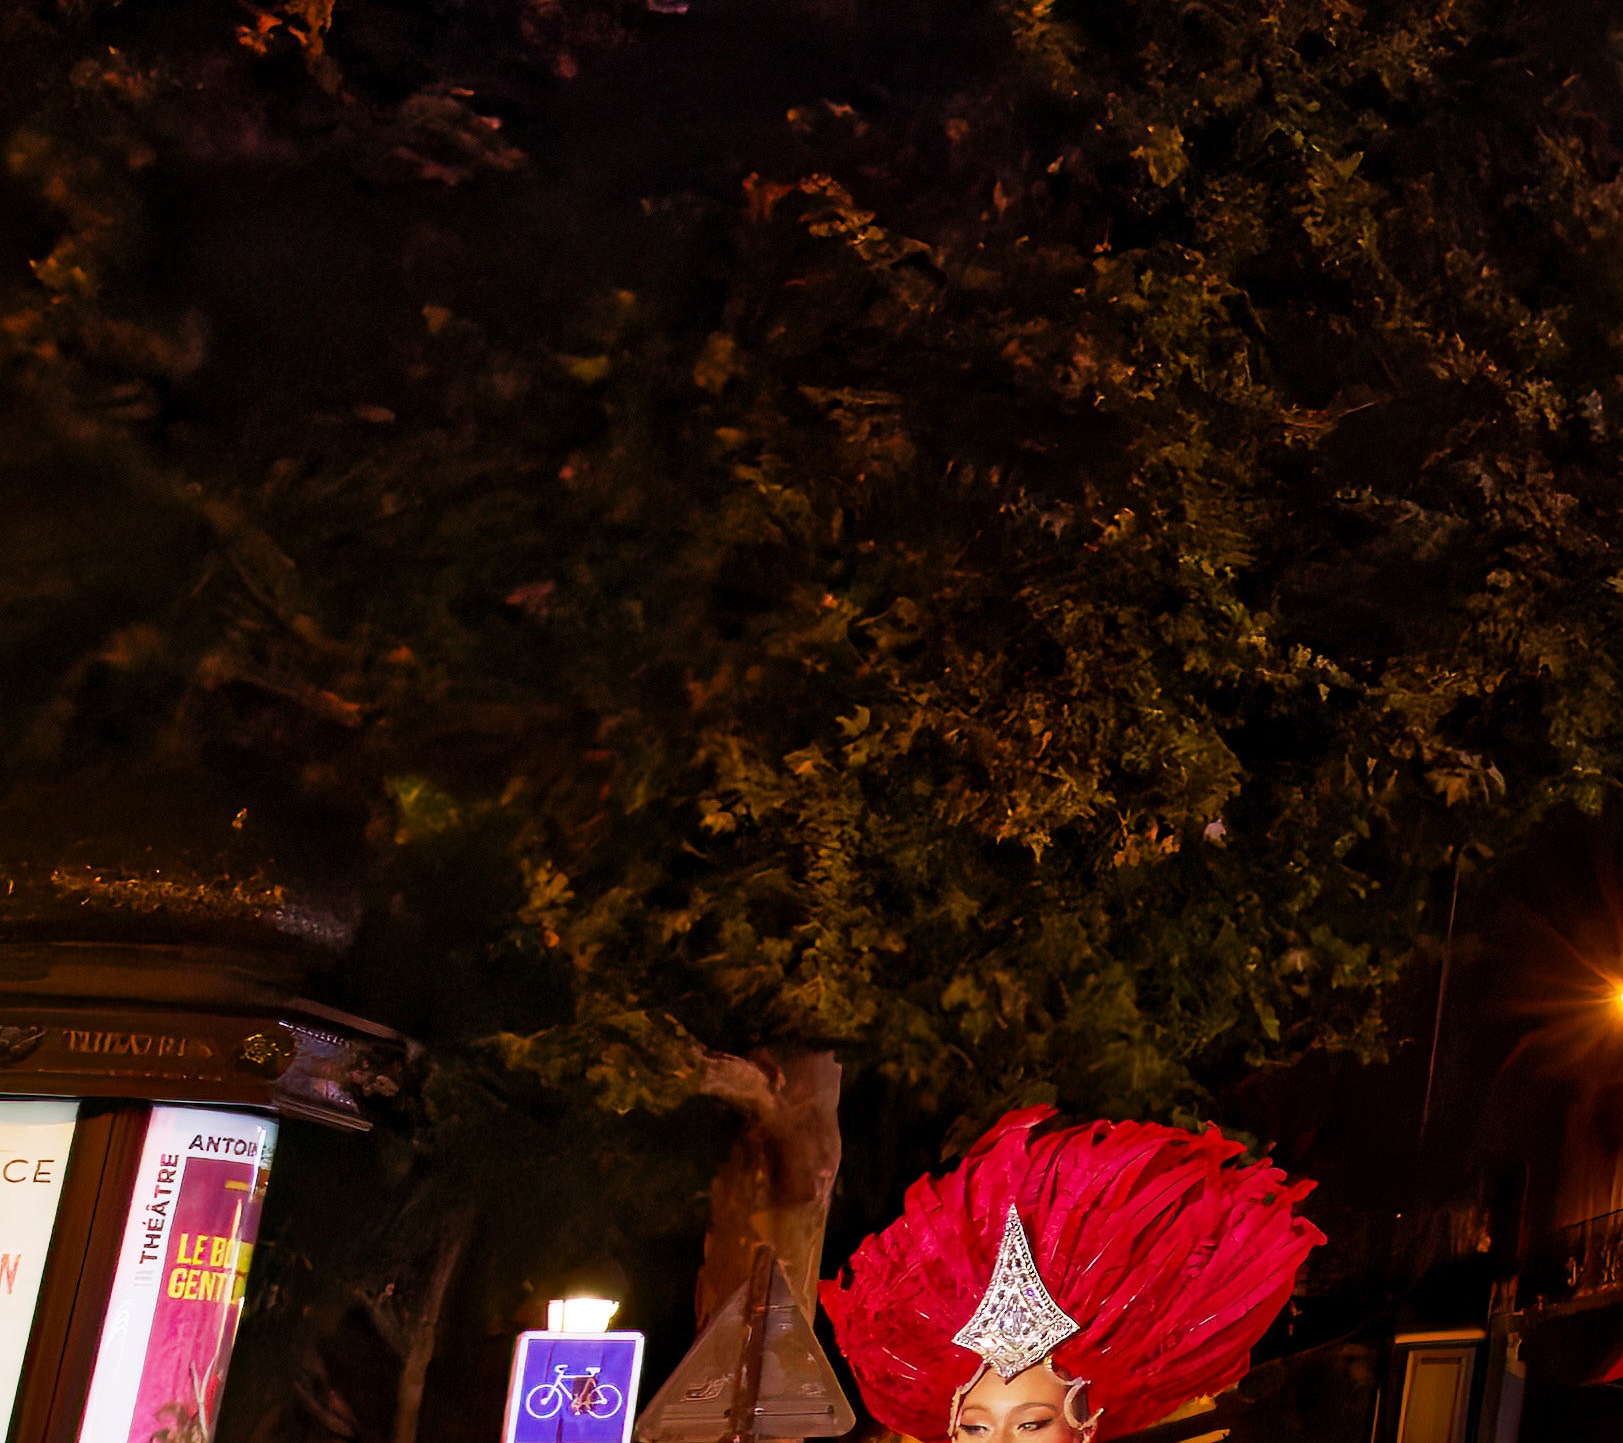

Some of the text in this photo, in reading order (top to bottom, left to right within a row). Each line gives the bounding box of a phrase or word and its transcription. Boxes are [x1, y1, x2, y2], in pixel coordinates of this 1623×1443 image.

[2, 1159, 55, 1184] CE
[139, 1153, 180, 1264] THÉÂTRE
[177, 1233, 209, 1265] LE
[167, 1267, 230, 1302] GENT
